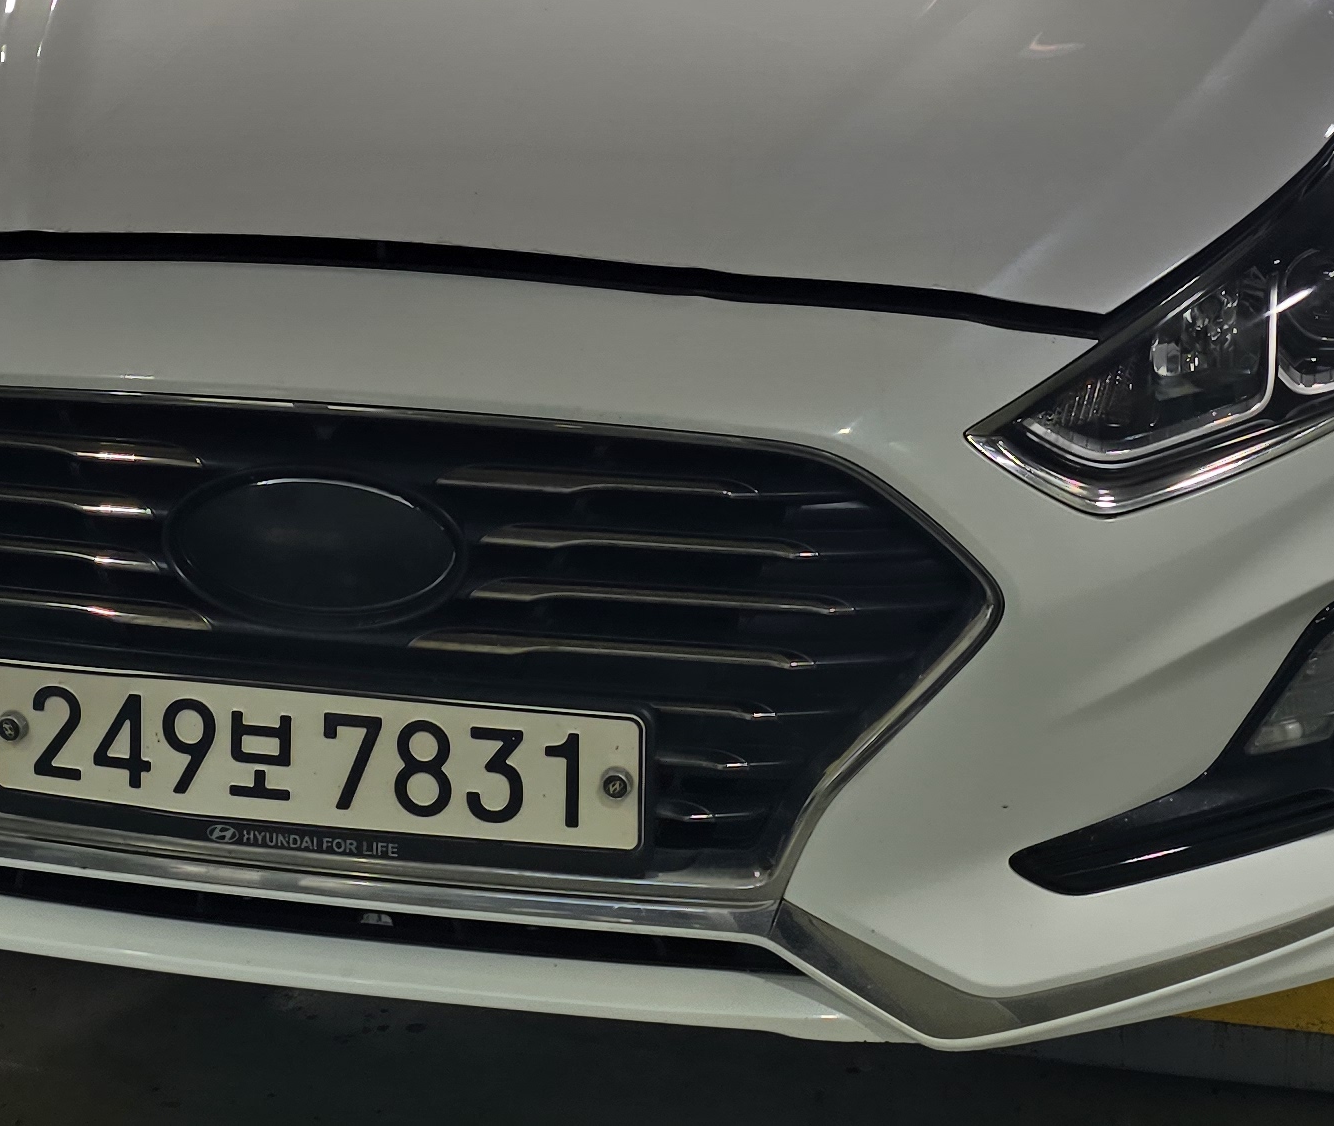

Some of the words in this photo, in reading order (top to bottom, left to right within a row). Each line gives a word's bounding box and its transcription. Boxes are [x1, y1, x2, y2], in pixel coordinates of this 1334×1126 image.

[243, 830, 317, 850] HYUNDAI
[322, 837, 358, 854] FOR
[362, 841, 399, 857] LIFE
